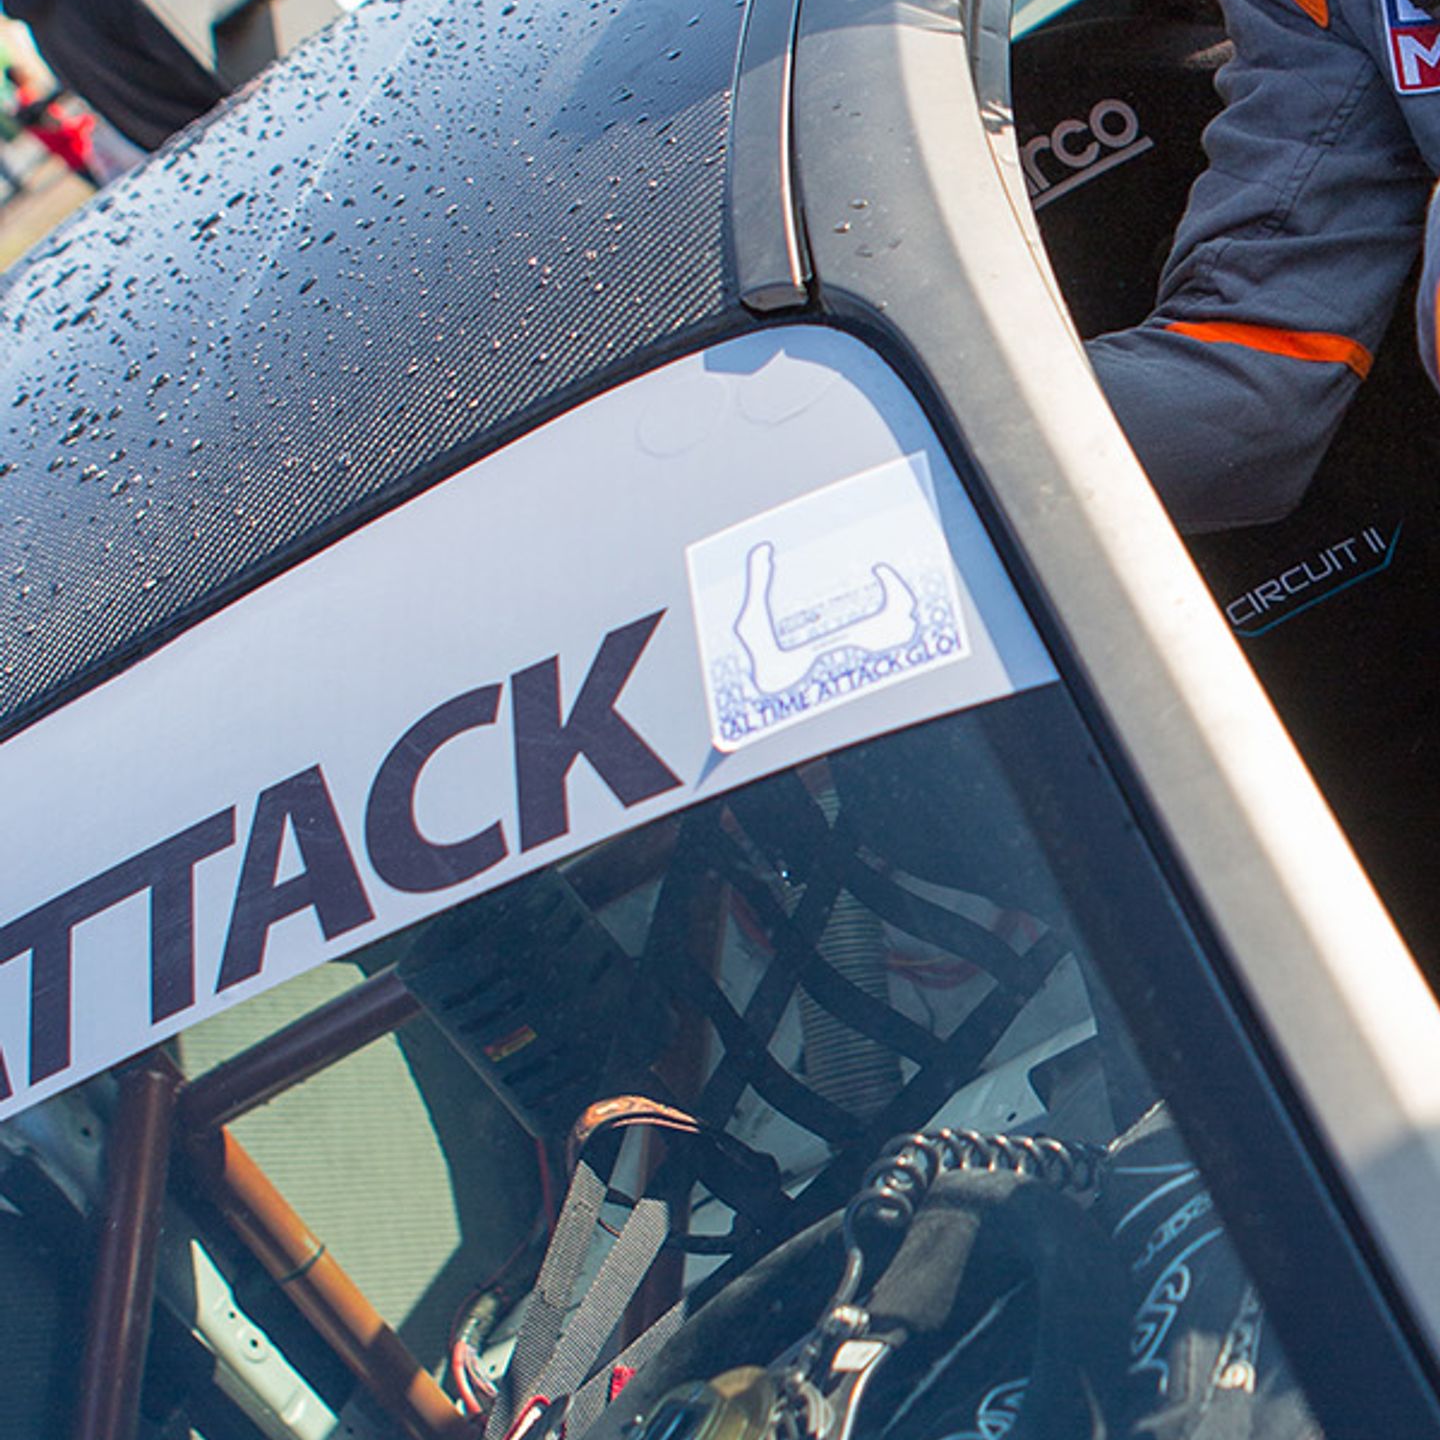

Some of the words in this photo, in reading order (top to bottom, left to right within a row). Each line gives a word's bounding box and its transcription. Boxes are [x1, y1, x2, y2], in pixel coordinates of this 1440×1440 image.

[1020, 97, 1142, 200] rco
[1226, 537, 1357, 626] CIRCUIT
[811, 654, 904, 706] ATTACK
[904, 630, 962, 667] GLO
[0, 607, 684, 1102] TTACK
